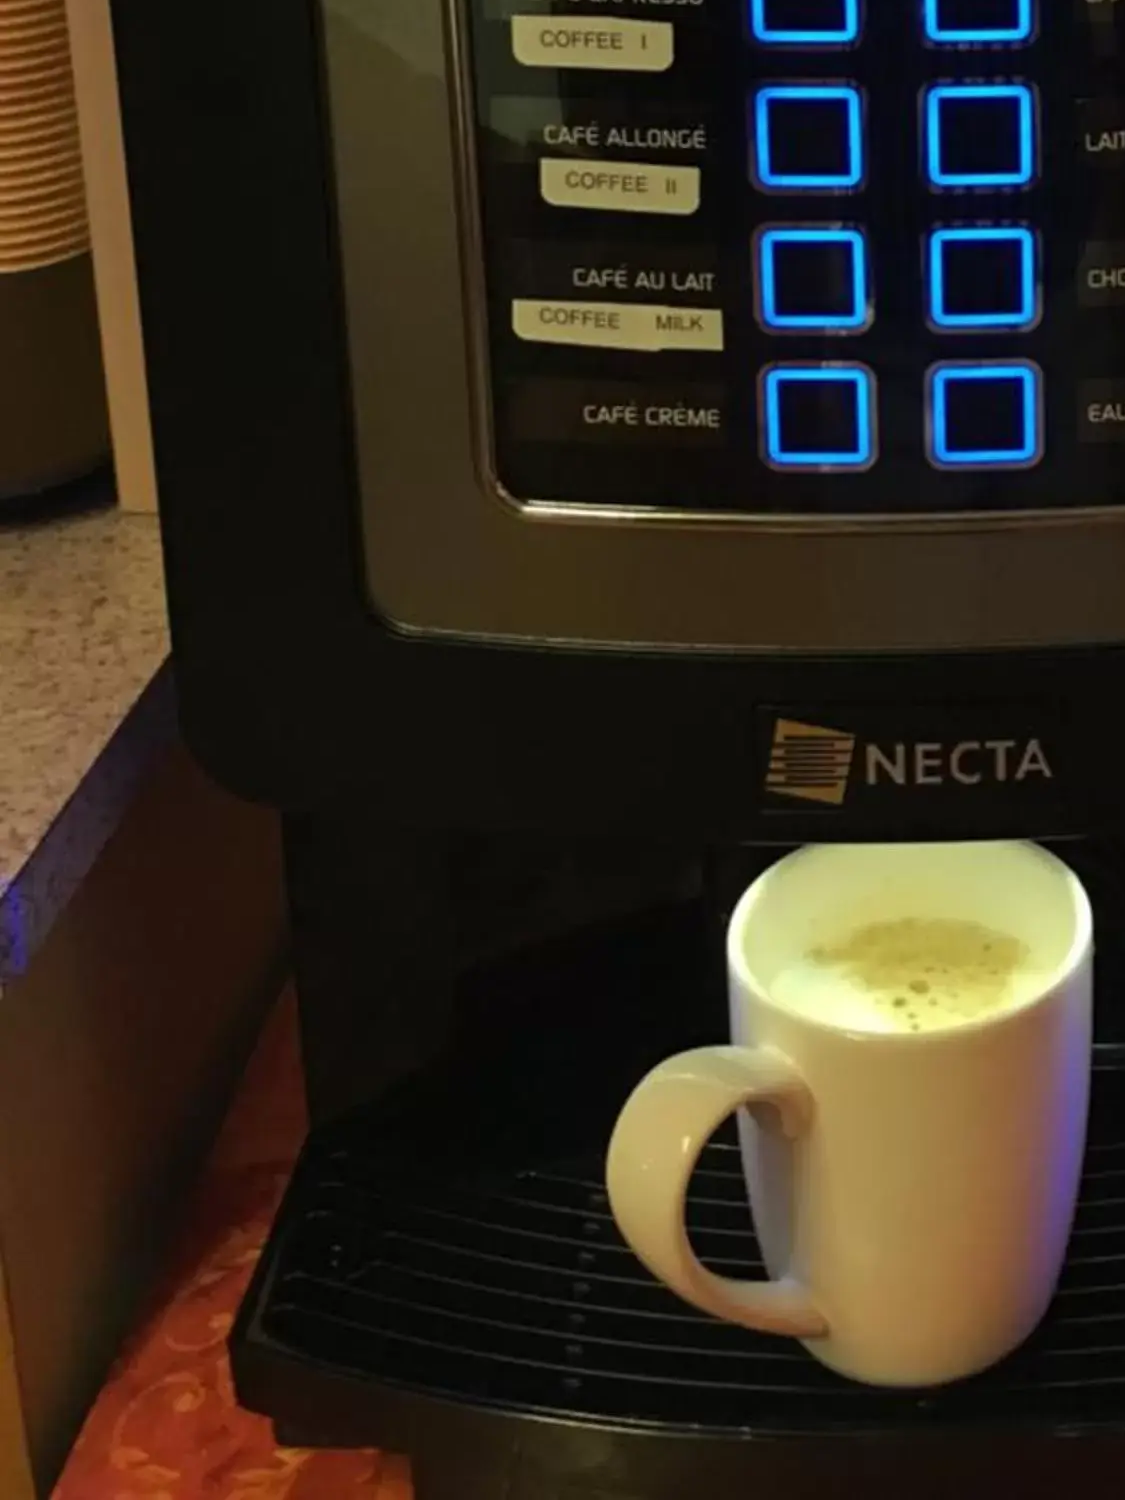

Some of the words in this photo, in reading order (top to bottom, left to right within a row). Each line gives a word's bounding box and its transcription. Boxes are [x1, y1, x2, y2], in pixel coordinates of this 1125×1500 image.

[539, 29, 624, 50] COFFEE
[543, 121, 600, 146] CAFÉ
[606, 124, 707, 149] ALLONGÉ
[564, 170, 649, 194] COFFEE
[572, 264, 628, 289] CAFÉ
[634, 271, 665, 291] AU
[671, 272, 715, 292] LAIT
[538, 306, 620, 330] COFFEE
[655, 314, 704, 332] MILK
[583, 403, 638, 425] CAFÉ
[645, 402, 721, 428] CRÈME
[865, 738, 1053, 786] NECTA
